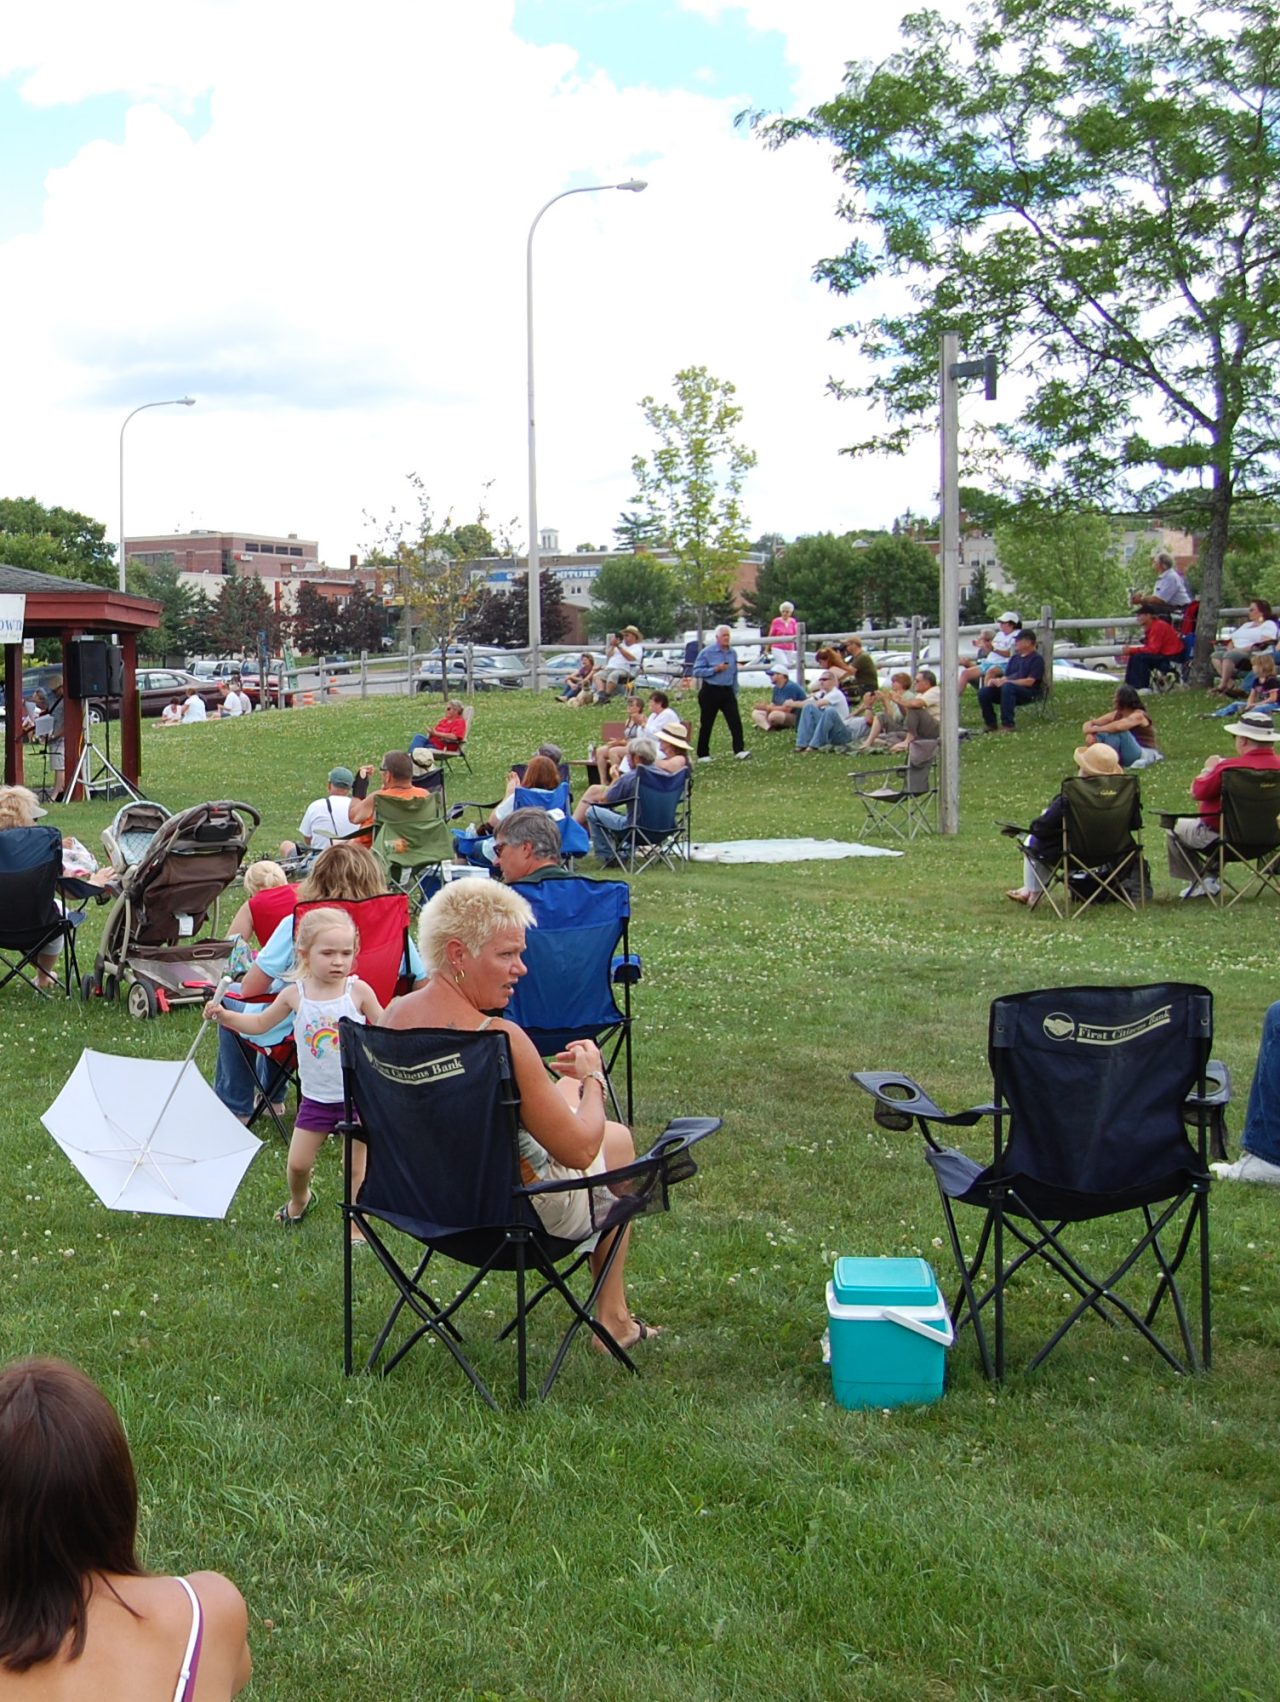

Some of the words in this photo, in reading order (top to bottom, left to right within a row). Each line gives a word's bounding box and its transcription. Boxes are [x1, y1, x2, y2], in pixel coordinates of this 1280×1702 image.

[1078, 1027, 1108, 1040] First
[1148, 1009, 1170, 1026] Bank
[431, 1058, 463, 1075] Bank
